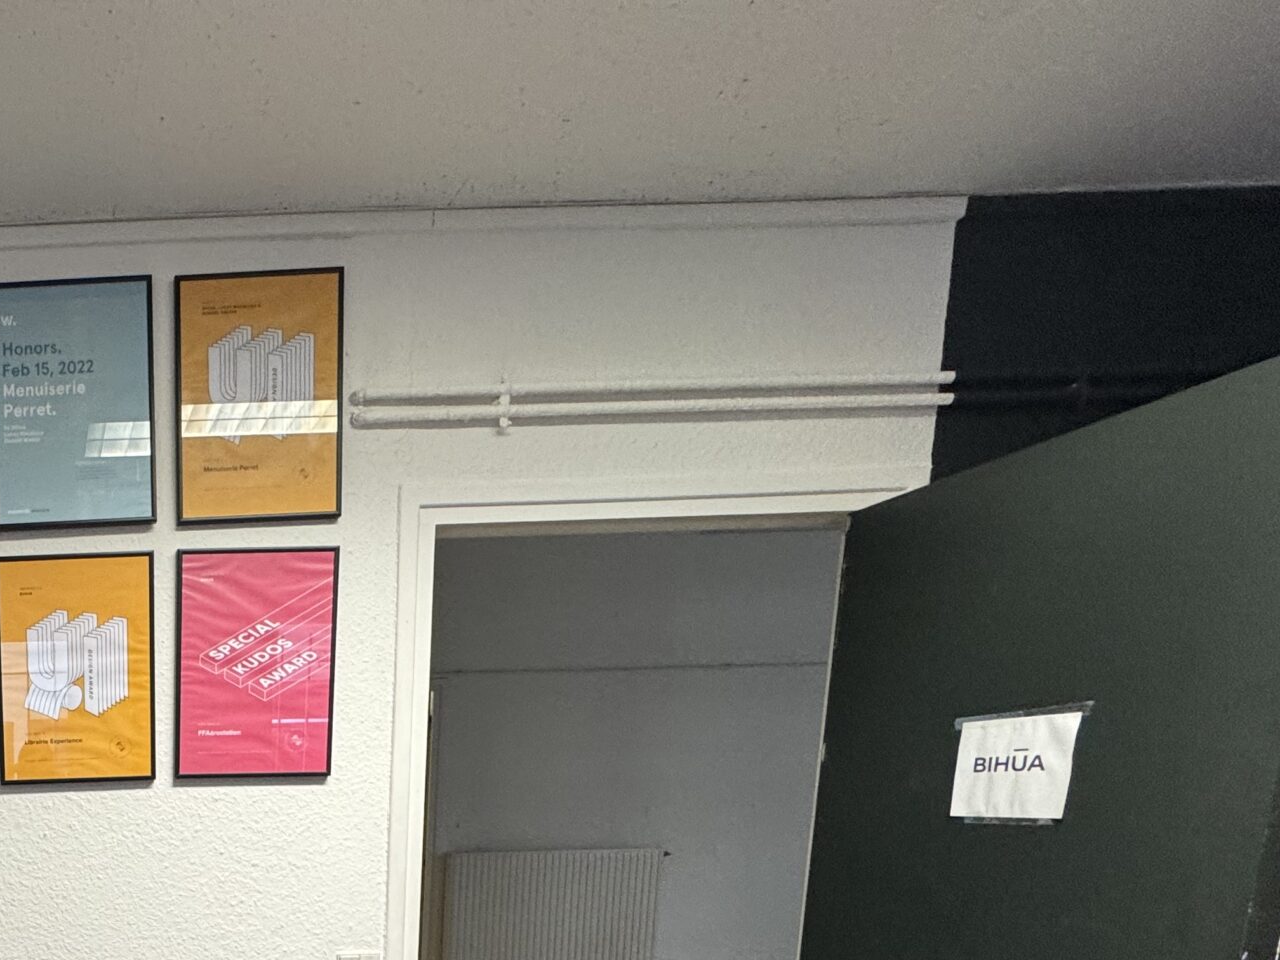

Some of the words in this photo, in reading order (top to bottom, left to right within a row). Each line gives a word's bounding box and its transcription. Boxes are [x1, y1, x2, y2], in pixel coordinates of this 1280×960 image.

[2, 342, 62, 357] Honors.
[2, 363, 30, 378] Feb
[35, 362, 54, 378] 15,
[59, 359, 94, 375] 2022
[3, 381, 86, 397] Menuiserie
[4, 403, 57, 418] Perret.
[208, 618, 281, 661] SPECIAL
[233, 638, 294, 675] KUDOS
[258, 651, 318, 689] AWARD
[50, 737, 83, 745] Experience
